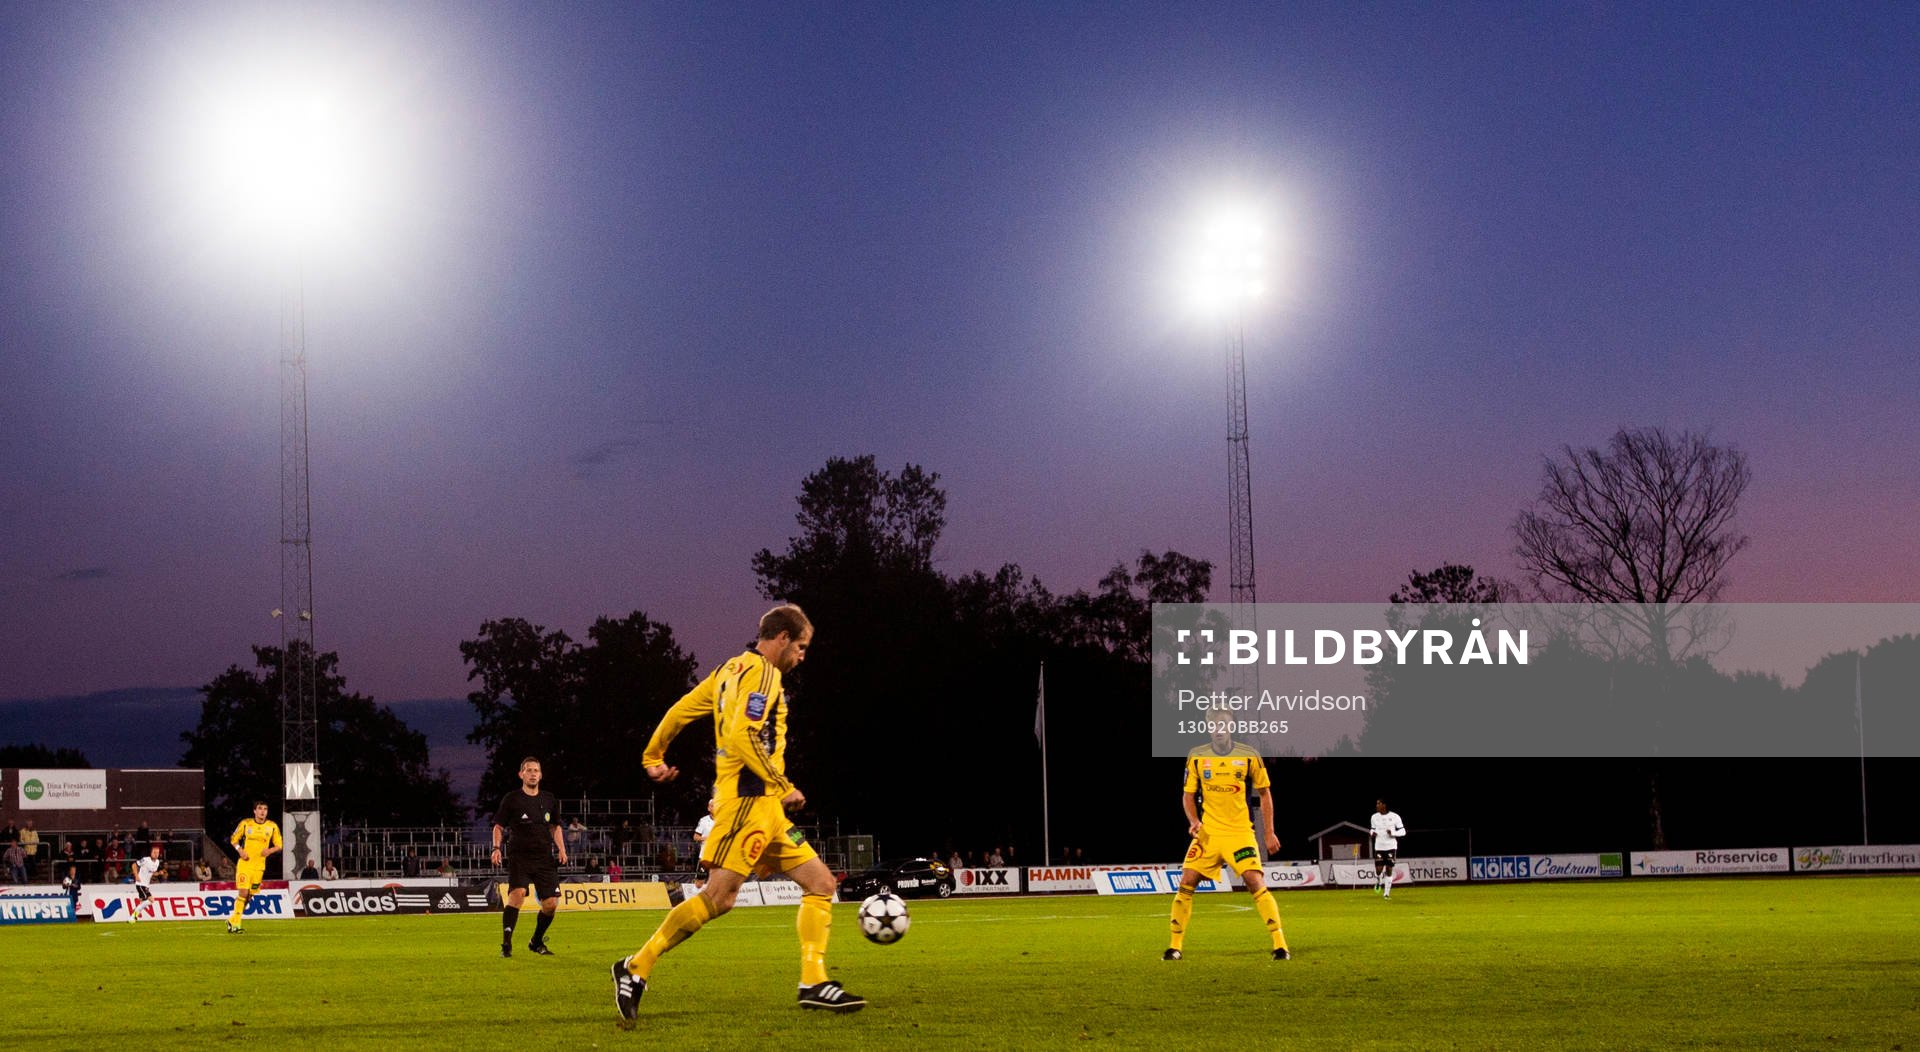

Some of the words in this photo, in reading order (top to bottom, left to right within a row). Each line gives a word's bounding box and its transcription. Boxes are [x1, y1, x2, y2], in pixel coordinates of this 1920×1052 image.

[1696, 851, 1778, 864] Rörservice
[1472, 857, 1530, 878] KÖKS
[1534, 857, 1597, 876] Centrum
[1650, 864, 1684, 874] bravida
[308, 891, 396, 914] adidas
[564, 888, 637, 905] POSTEN!
